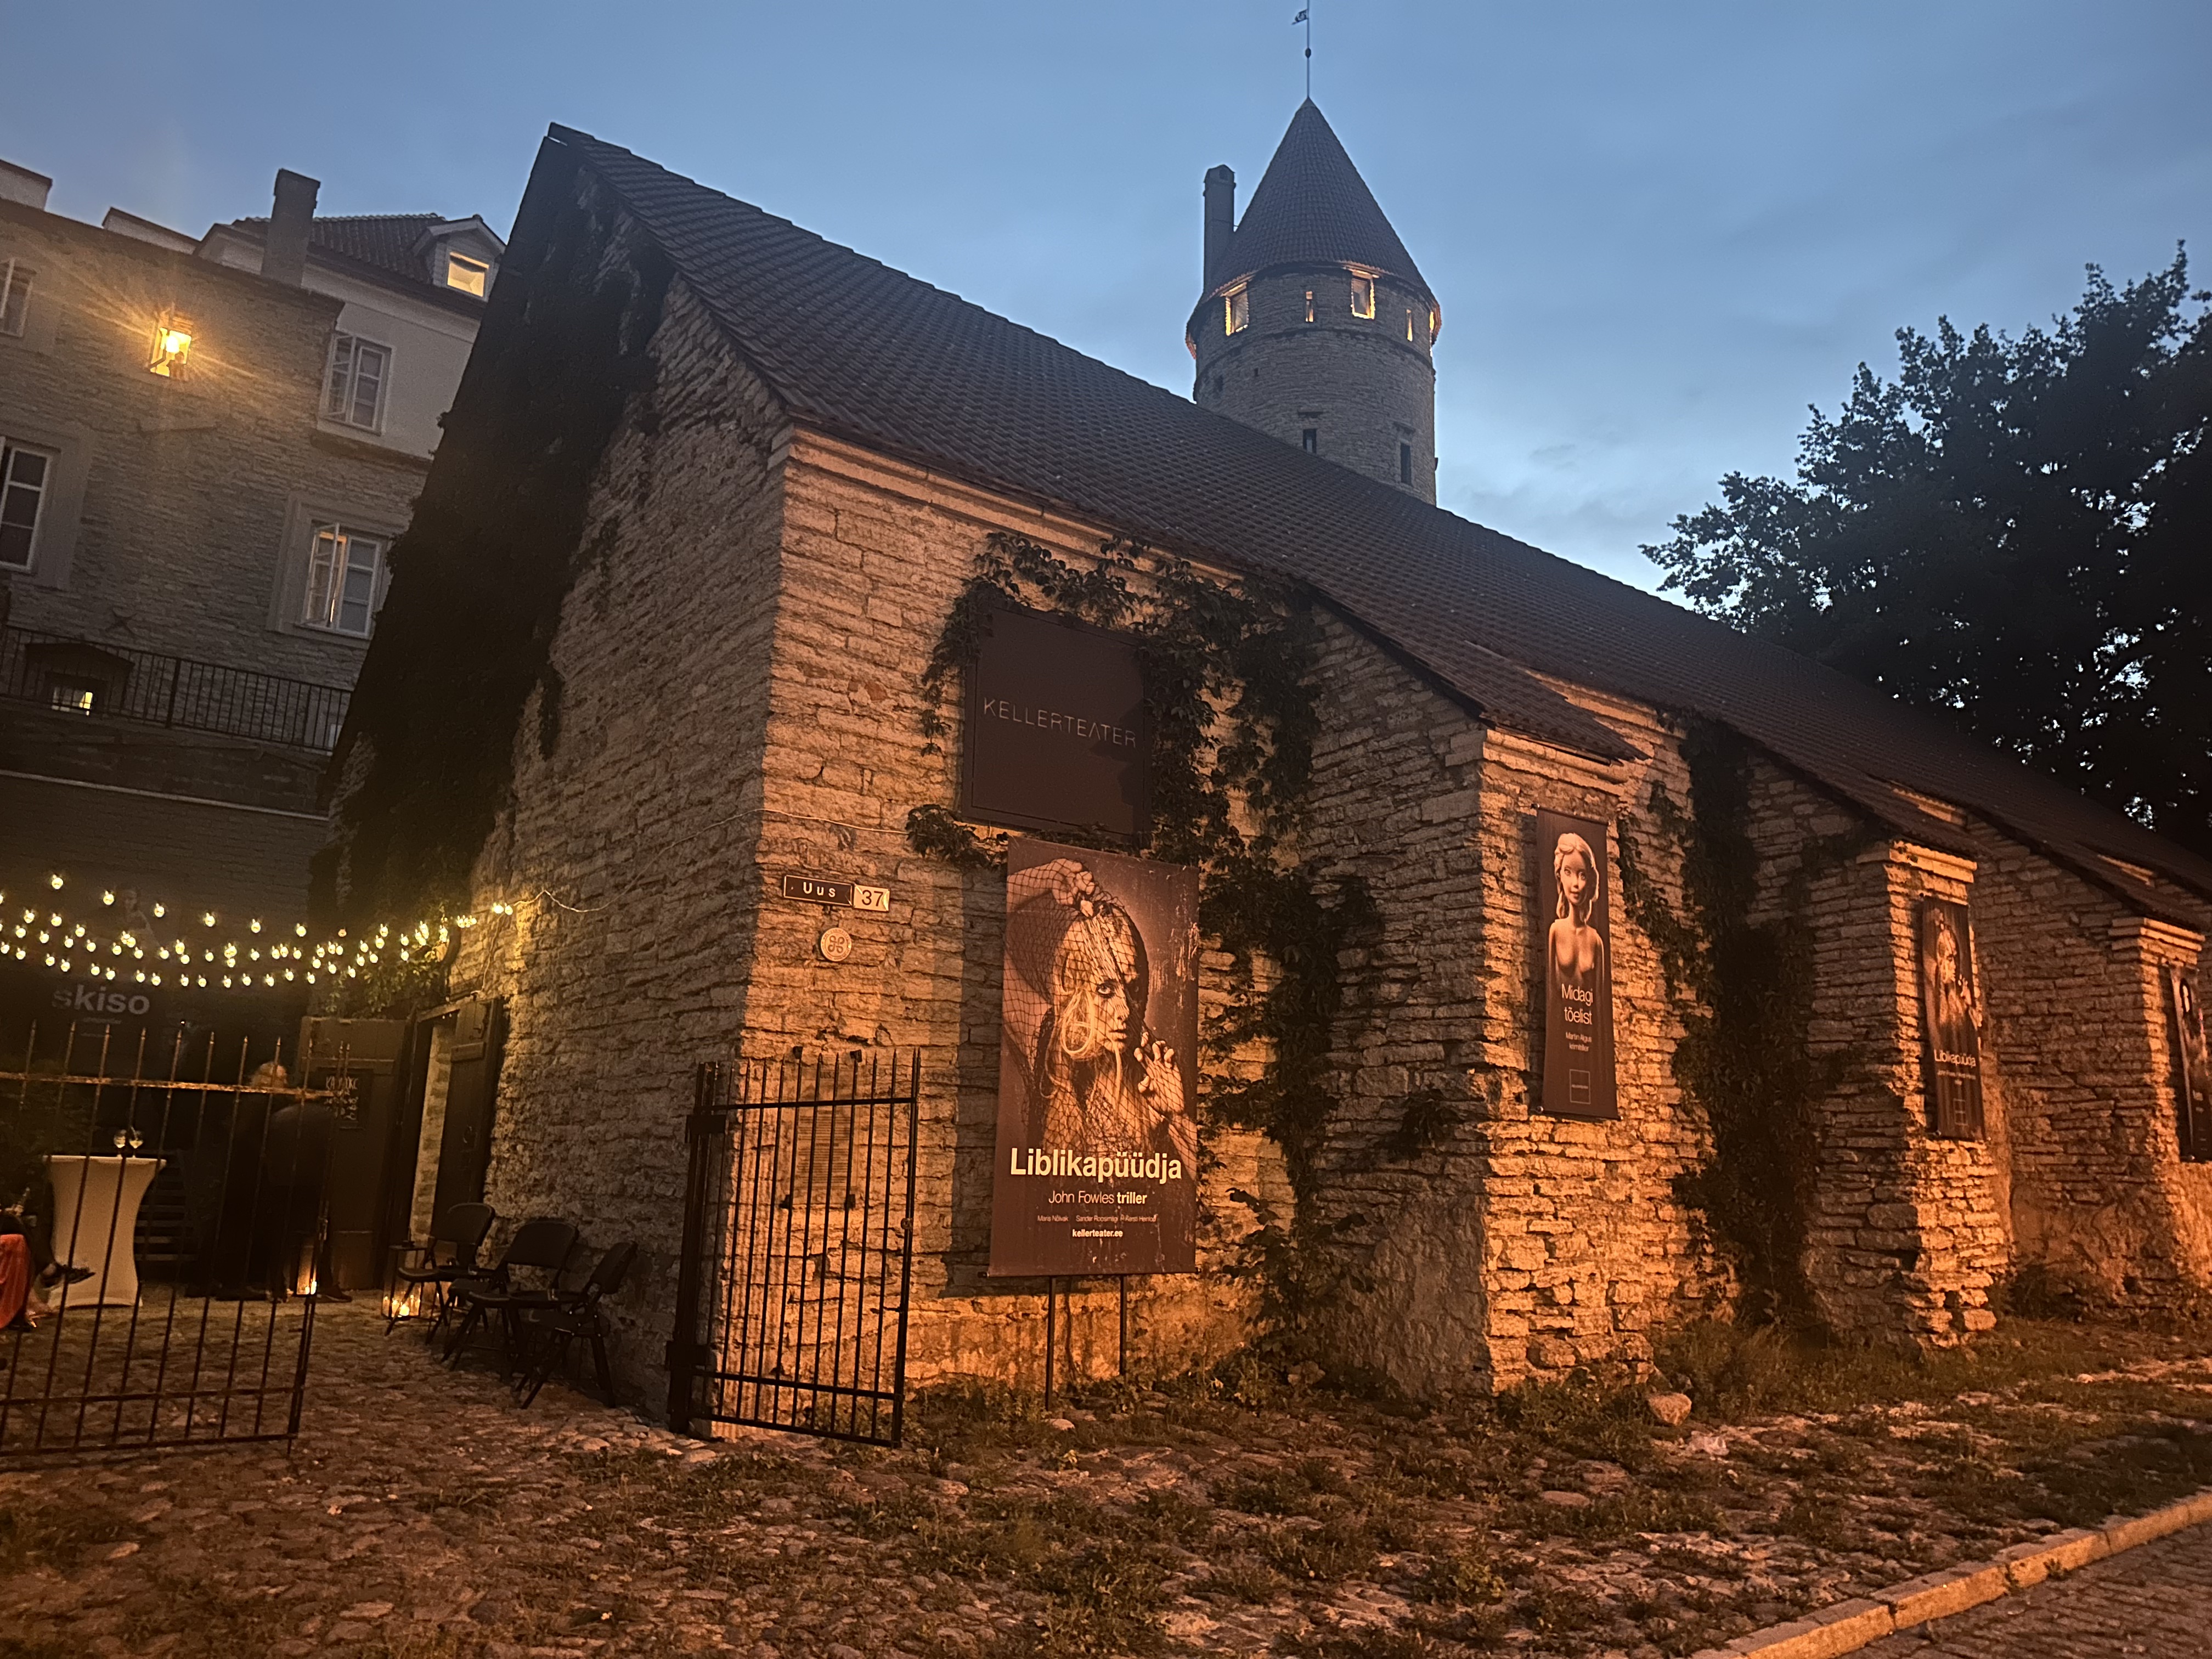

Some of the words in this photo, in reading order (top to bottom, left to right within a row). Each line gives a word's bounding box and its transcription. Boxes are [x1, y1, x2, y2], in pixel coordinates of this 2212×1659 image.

[984, 697, 1136, 748] KELLERTEATER
[803, 882, 836, 898] Uus
[861, 889, 884, 907] 37
[1561, 983, 1594, 1007] Midagi
[1564, 1007, 1593, 1025] tõelist
[1010, 1148, 1182, 1184] Liblikapüüdja
[1048, 1190, 1075, 1204] John
[1078, 1190, 1114, 1204] Fowles
[1116, 1191, 1148, 1204] triller
[1072, 1228, 1123, 1238] kellerteater.ee
